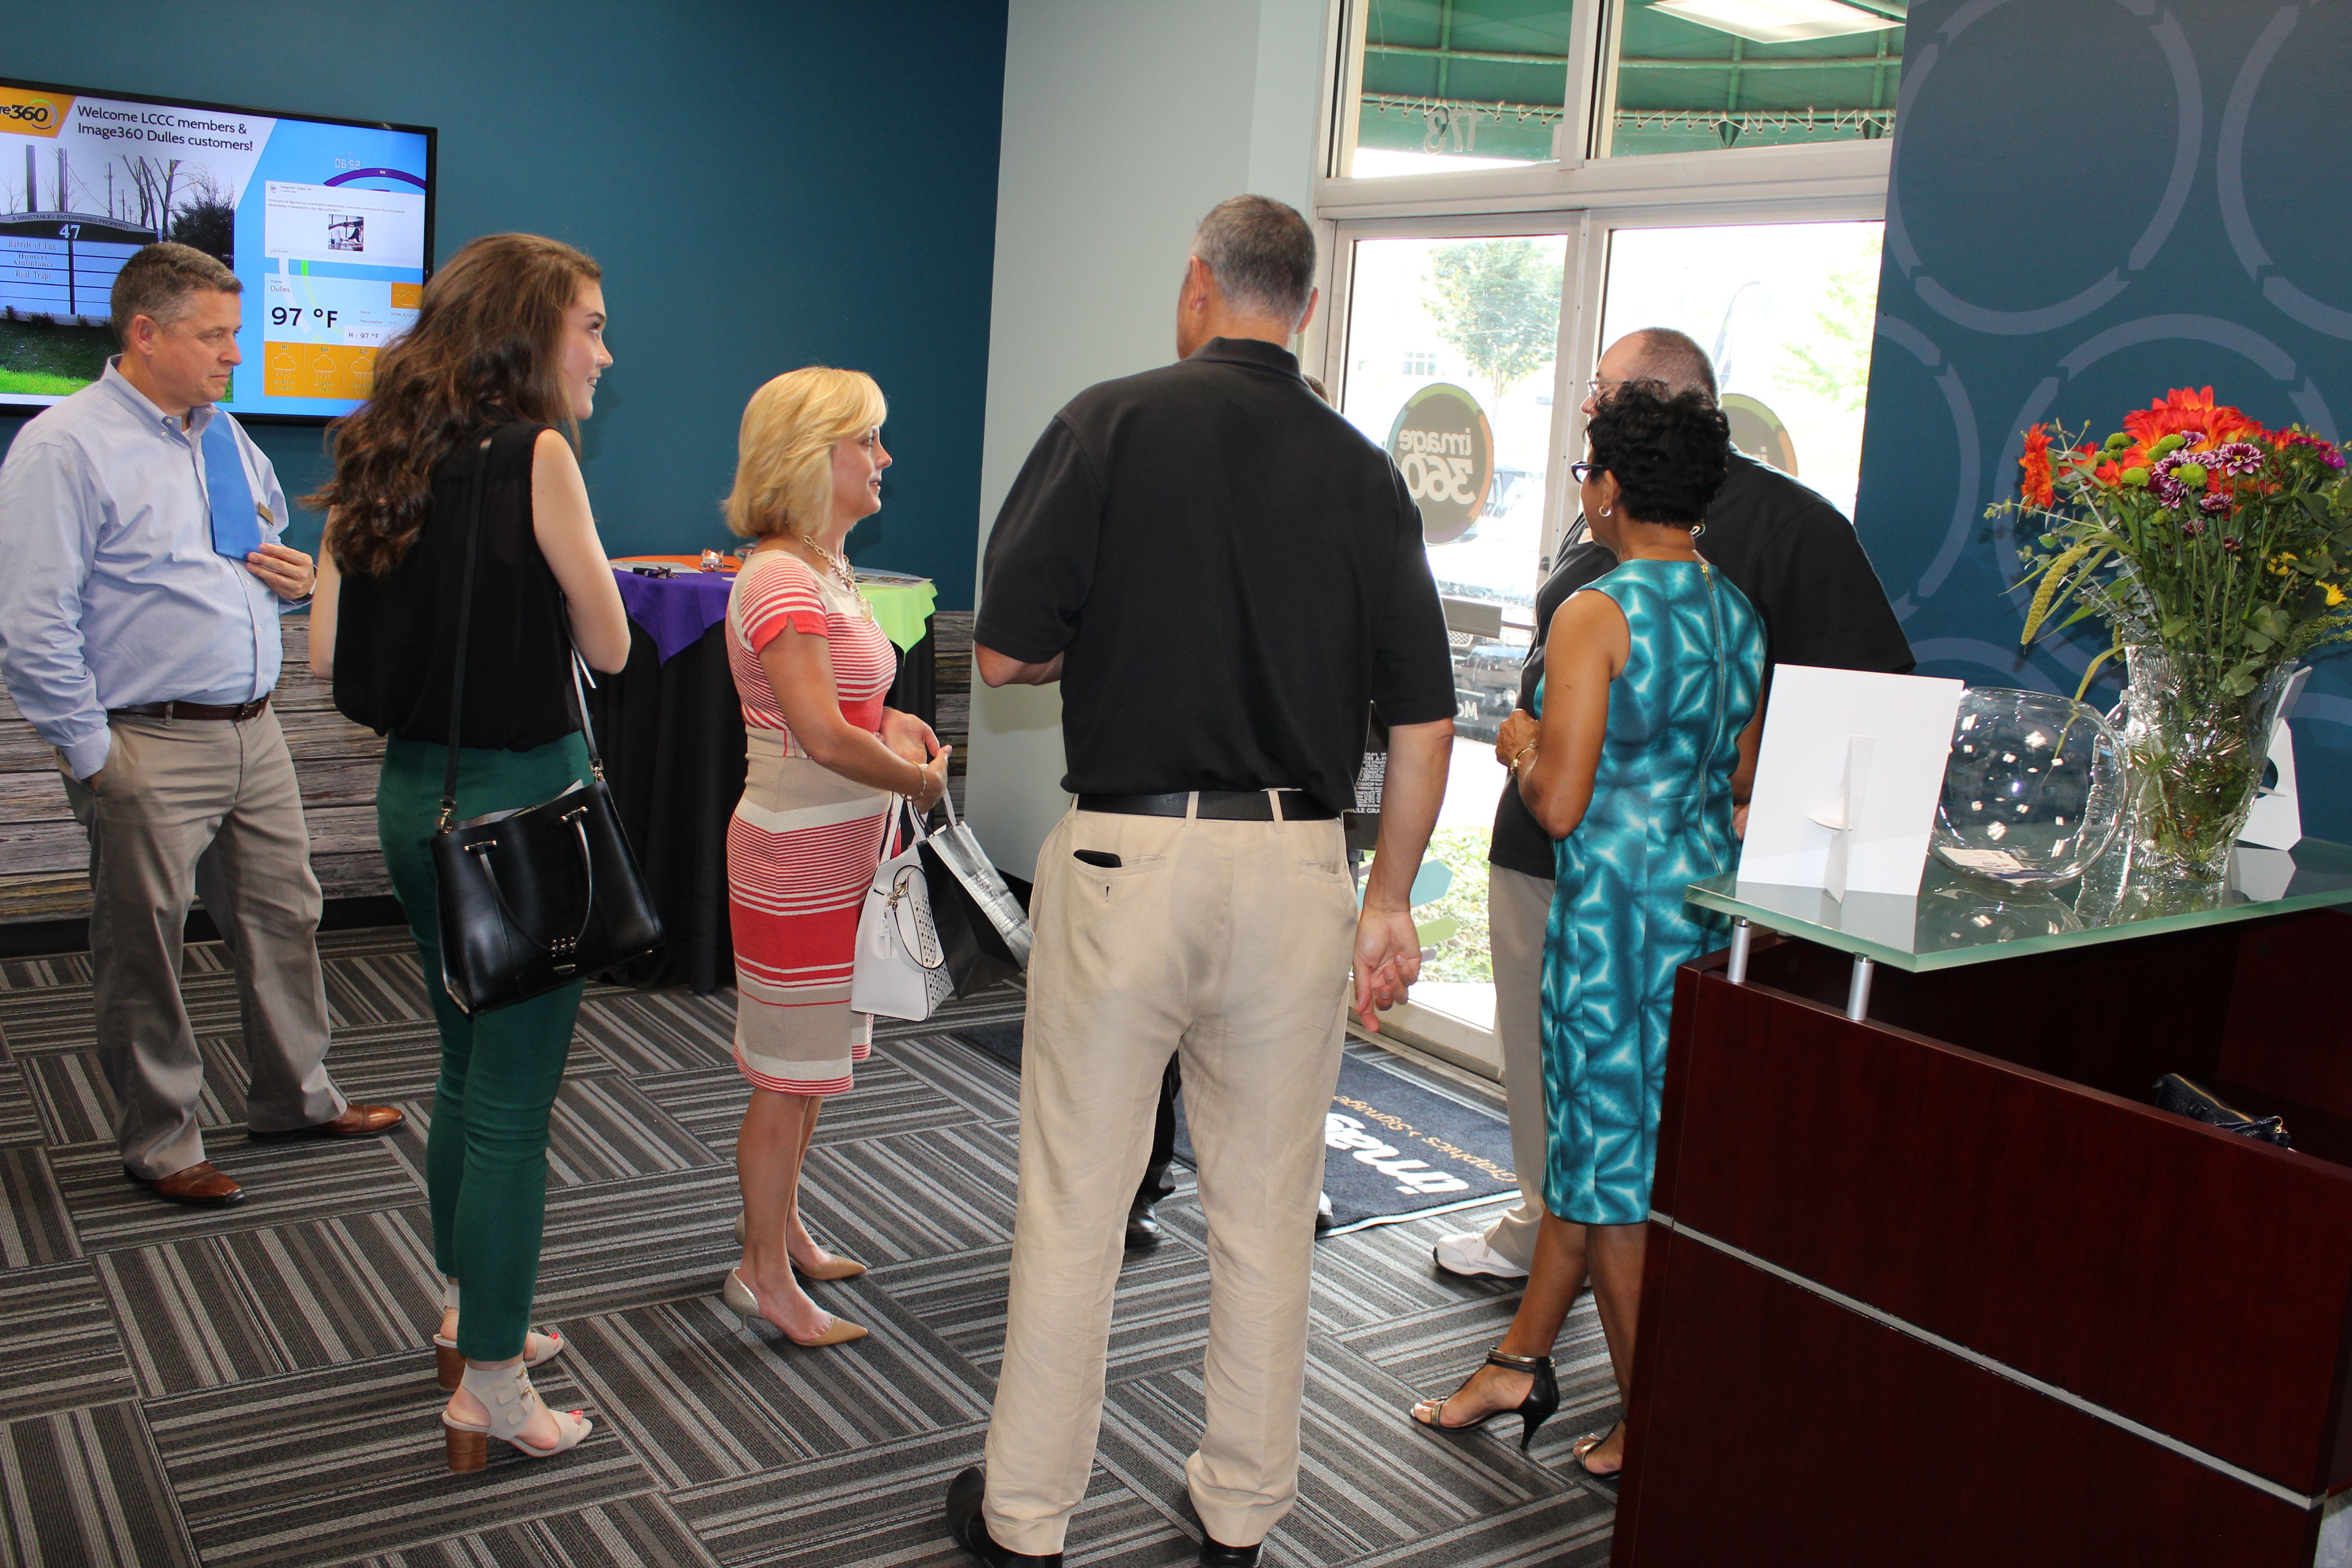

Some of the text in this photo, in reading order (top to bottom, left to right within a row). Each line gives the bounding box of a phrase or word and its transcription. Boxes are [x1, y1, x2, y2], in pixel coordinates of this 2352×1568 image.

[77, 105, 247, 134] Welcome LCCC members &
[78, 122, 253, 151] Image360 Dulles customers!
[335, 159, 361, 170] 06:52
[57, 215, 98, 223] ENTERPRISES
[99, 219, 130, 230] PROPERTY
[59, 224, 81, 240] 47
[8, 240, 56, 250] Barrels of Fun
[16, 270, 51, 281] Real Traps
[272, 307, 338, 328] 97 °F
[1333, 1096, 1517, 1182] Graphics Signage
